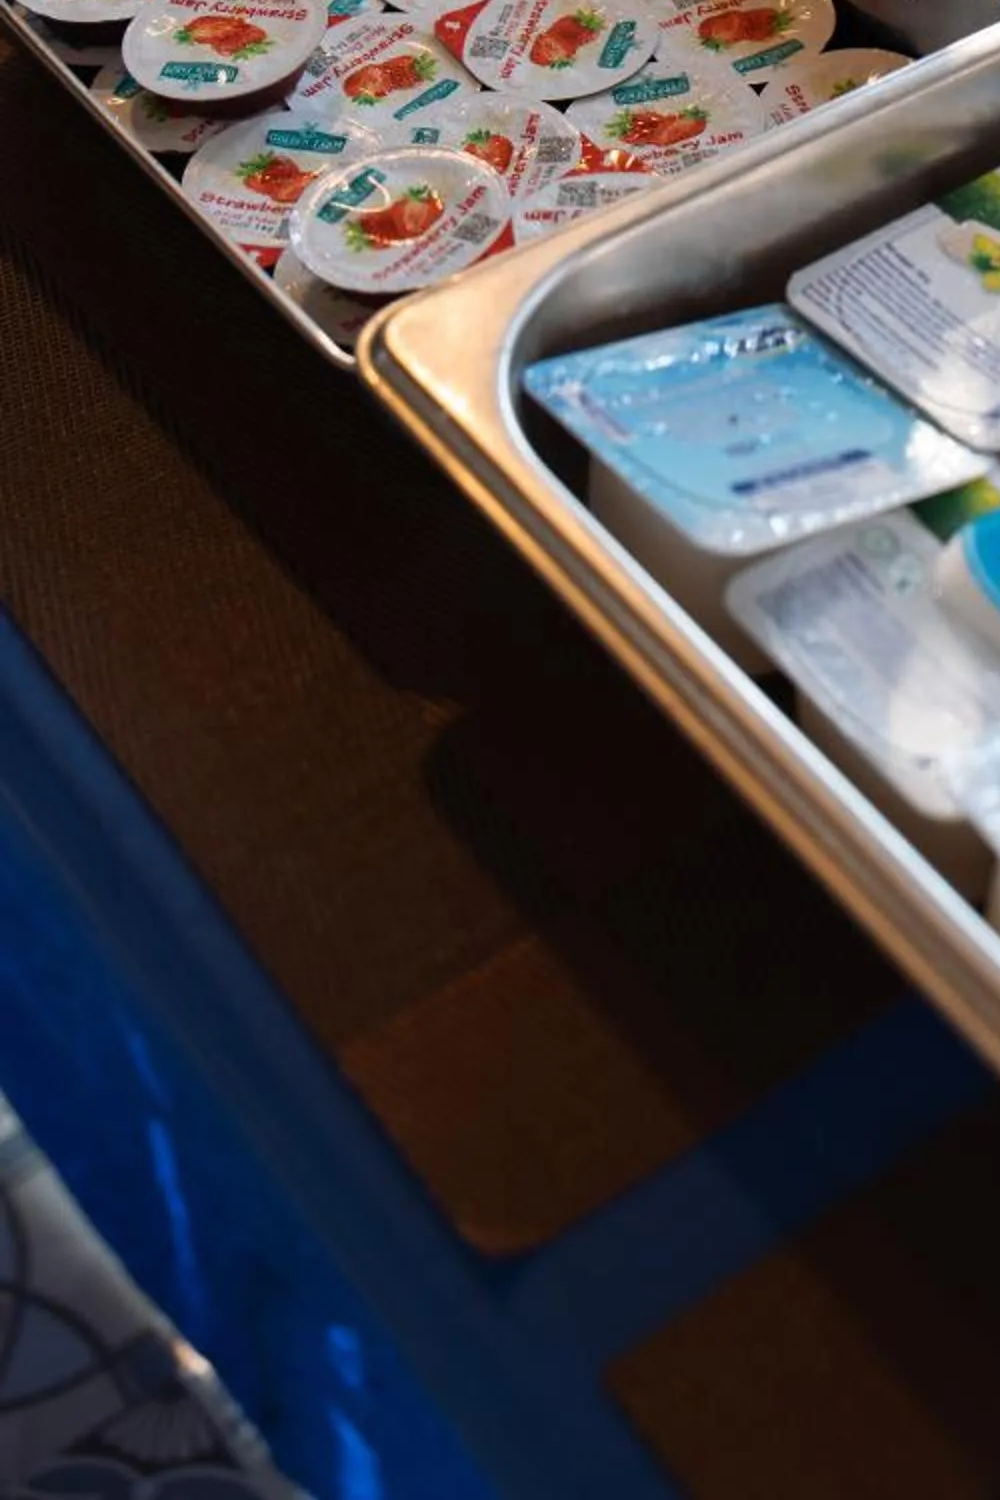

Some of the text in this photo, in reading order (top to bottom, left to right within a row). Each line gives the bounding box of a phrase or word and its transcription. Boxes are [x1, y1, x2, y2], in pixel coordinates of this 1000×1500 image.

[215, 0, 307, 24] Strawberry
[501, 58, 518, 80] Jam
[302, 75, 332, 99] Jam
[707, 131, 743, 147] Jam
[200, 190, 293, 217] Strawber
[455, 184, 488, 214] Jam
[526, 208, 565, 224] Jam
